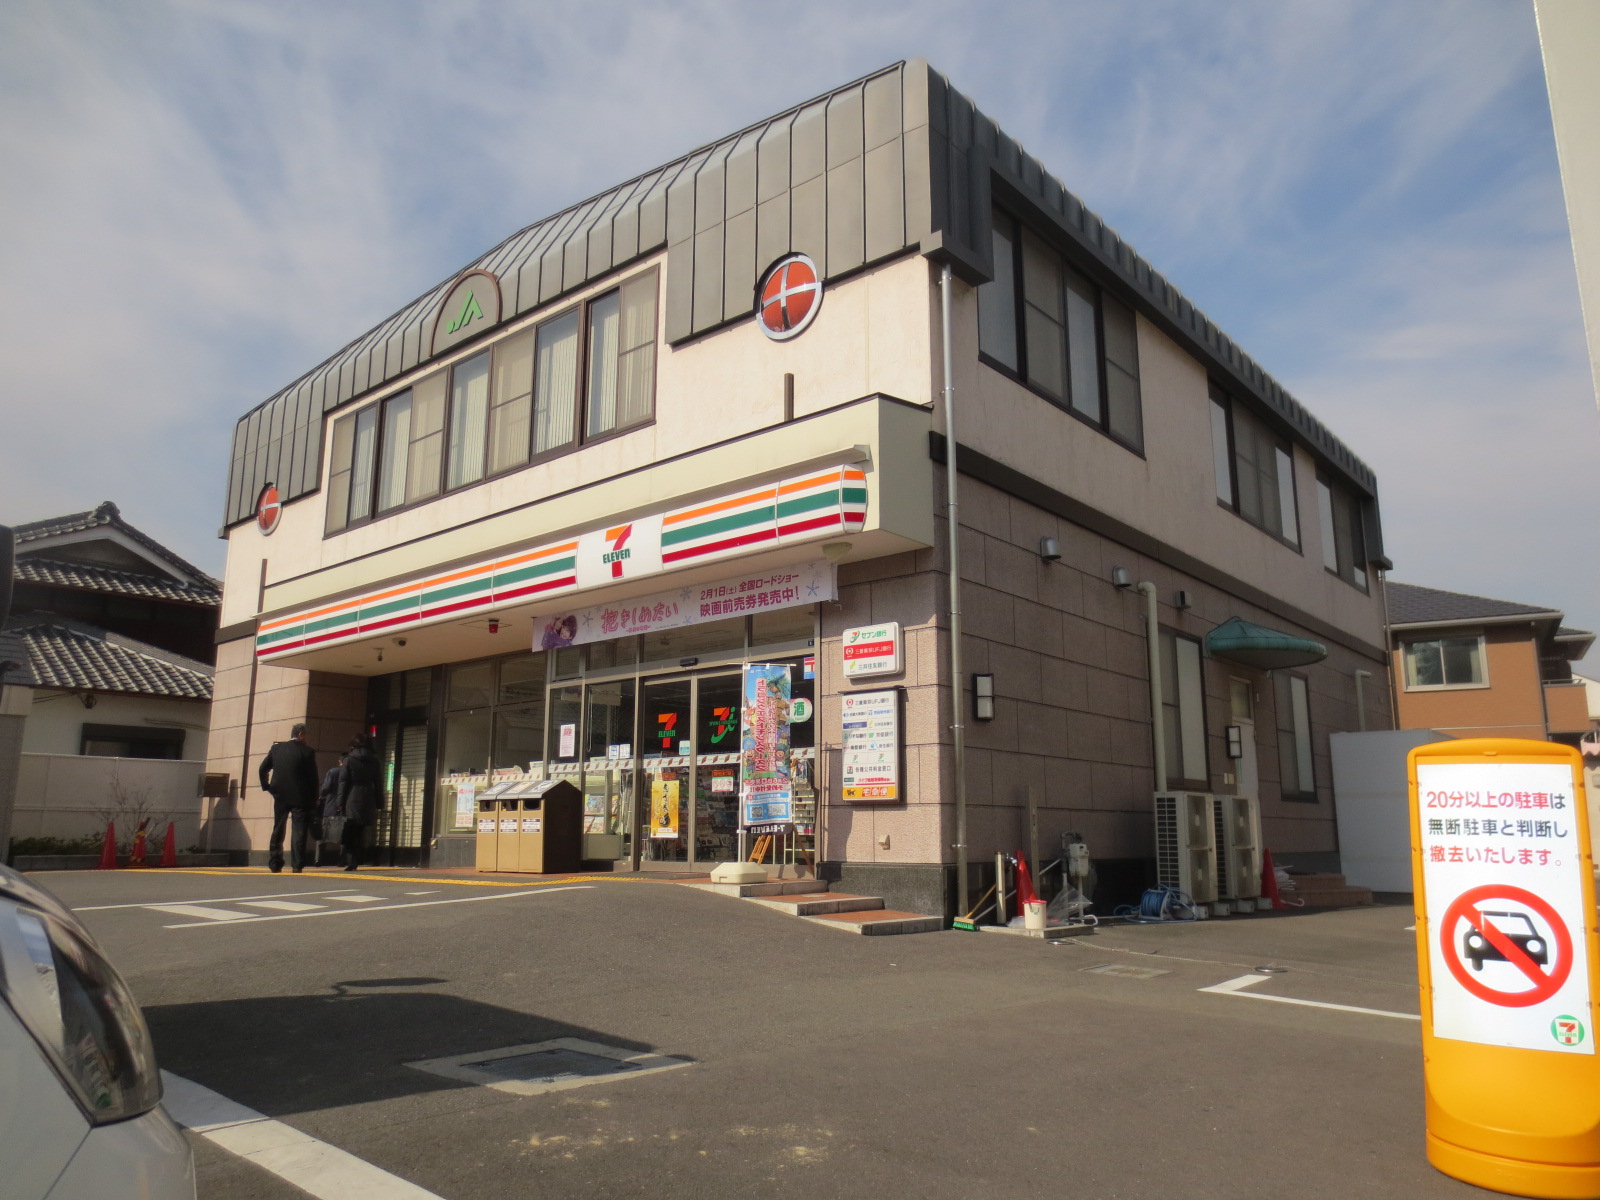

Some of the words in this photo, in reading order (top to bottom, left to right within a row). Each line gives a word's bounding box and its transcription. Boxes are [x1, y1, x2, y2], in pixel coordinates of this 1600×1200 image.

[602, 548, 630, 563] ELEVEN
[605, 523, 632, 578] 7
[739, 574, 799, 593] 全国ロードショー
[700, 585, 799, 617] 映画前売券発売中!
[601, 602, 679, 633] 抱きしめたい
[861, 630, 887, 639] セブン銀行
[858, 662, 888, 671] 三井住友銀行
[794, 702, 804, 716] 酒
[658, 730, 676, 738] ELEVEN
[1426, 791, 1566, 810] 20分以上の駐車は
[1428, 818, 1568, 838] 無断駐車と判断し
[1430, 845, 1562, 867] 撤去いたします。
